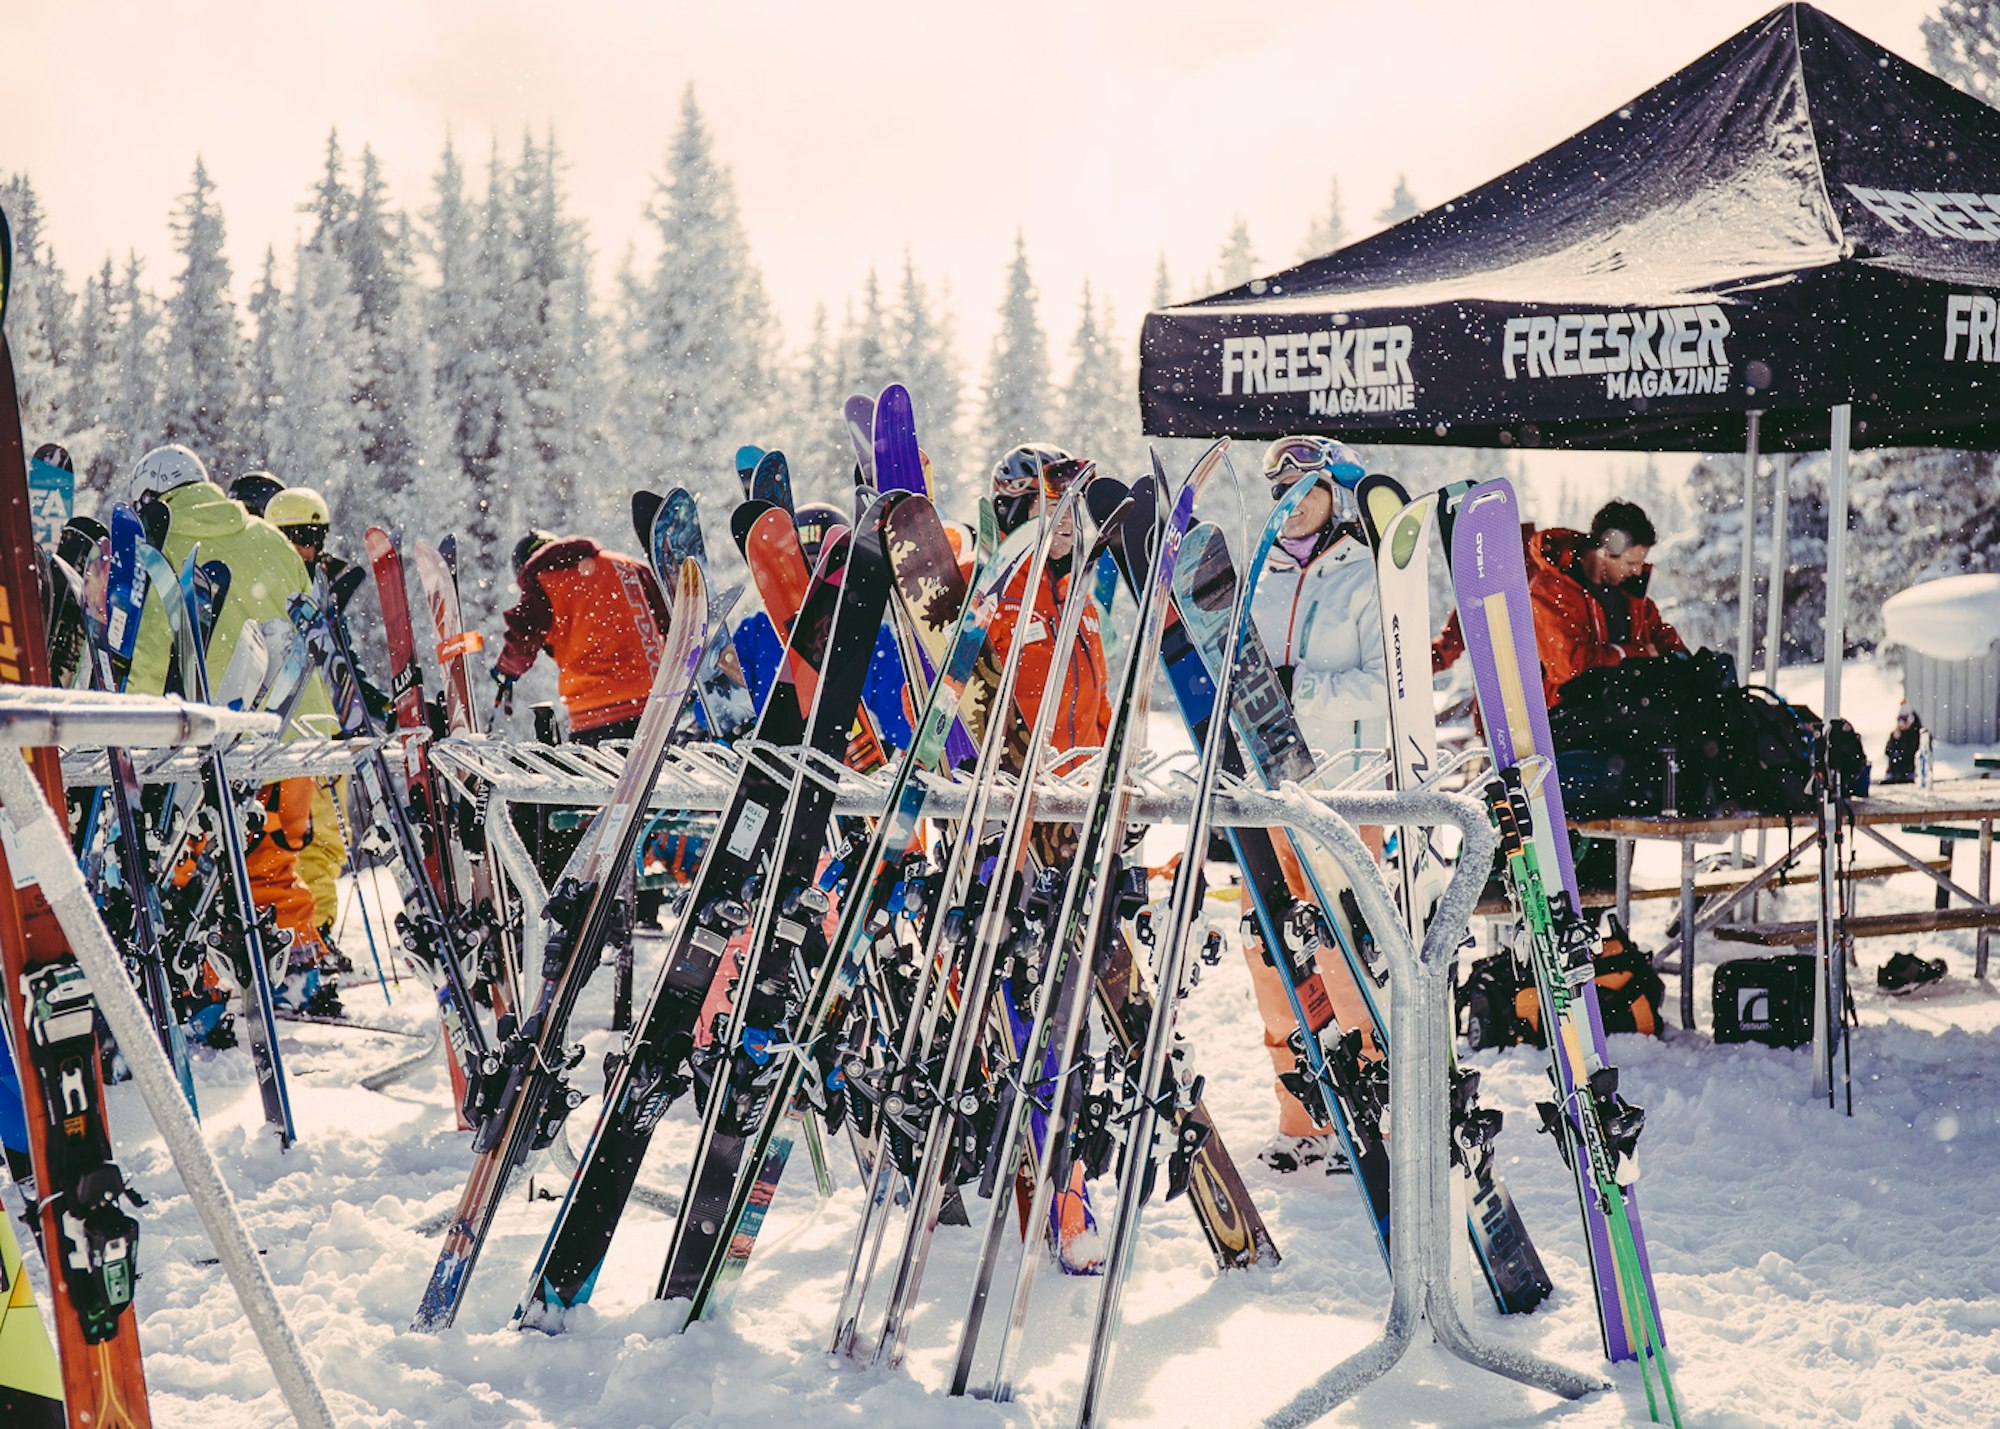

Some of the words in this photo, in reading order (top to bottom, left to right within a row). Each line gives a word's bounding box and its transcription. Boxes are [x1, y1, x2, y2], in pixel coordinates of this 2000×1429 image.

[1843, 183, 2000, 242] FREE
[1502, 304, 1730, 380] FREESKIER
[1944, 294, 2000, 362] FR
[1221, 324, 1414, 396] FREESKIER
[1606, 365, 1730, 399] MAGAZINE
[1309, 383, 1416, 416] MAGAZINE
[1475, 531, 1485, 579] HEAD
[611, 560, 662, 690] AKLEY
